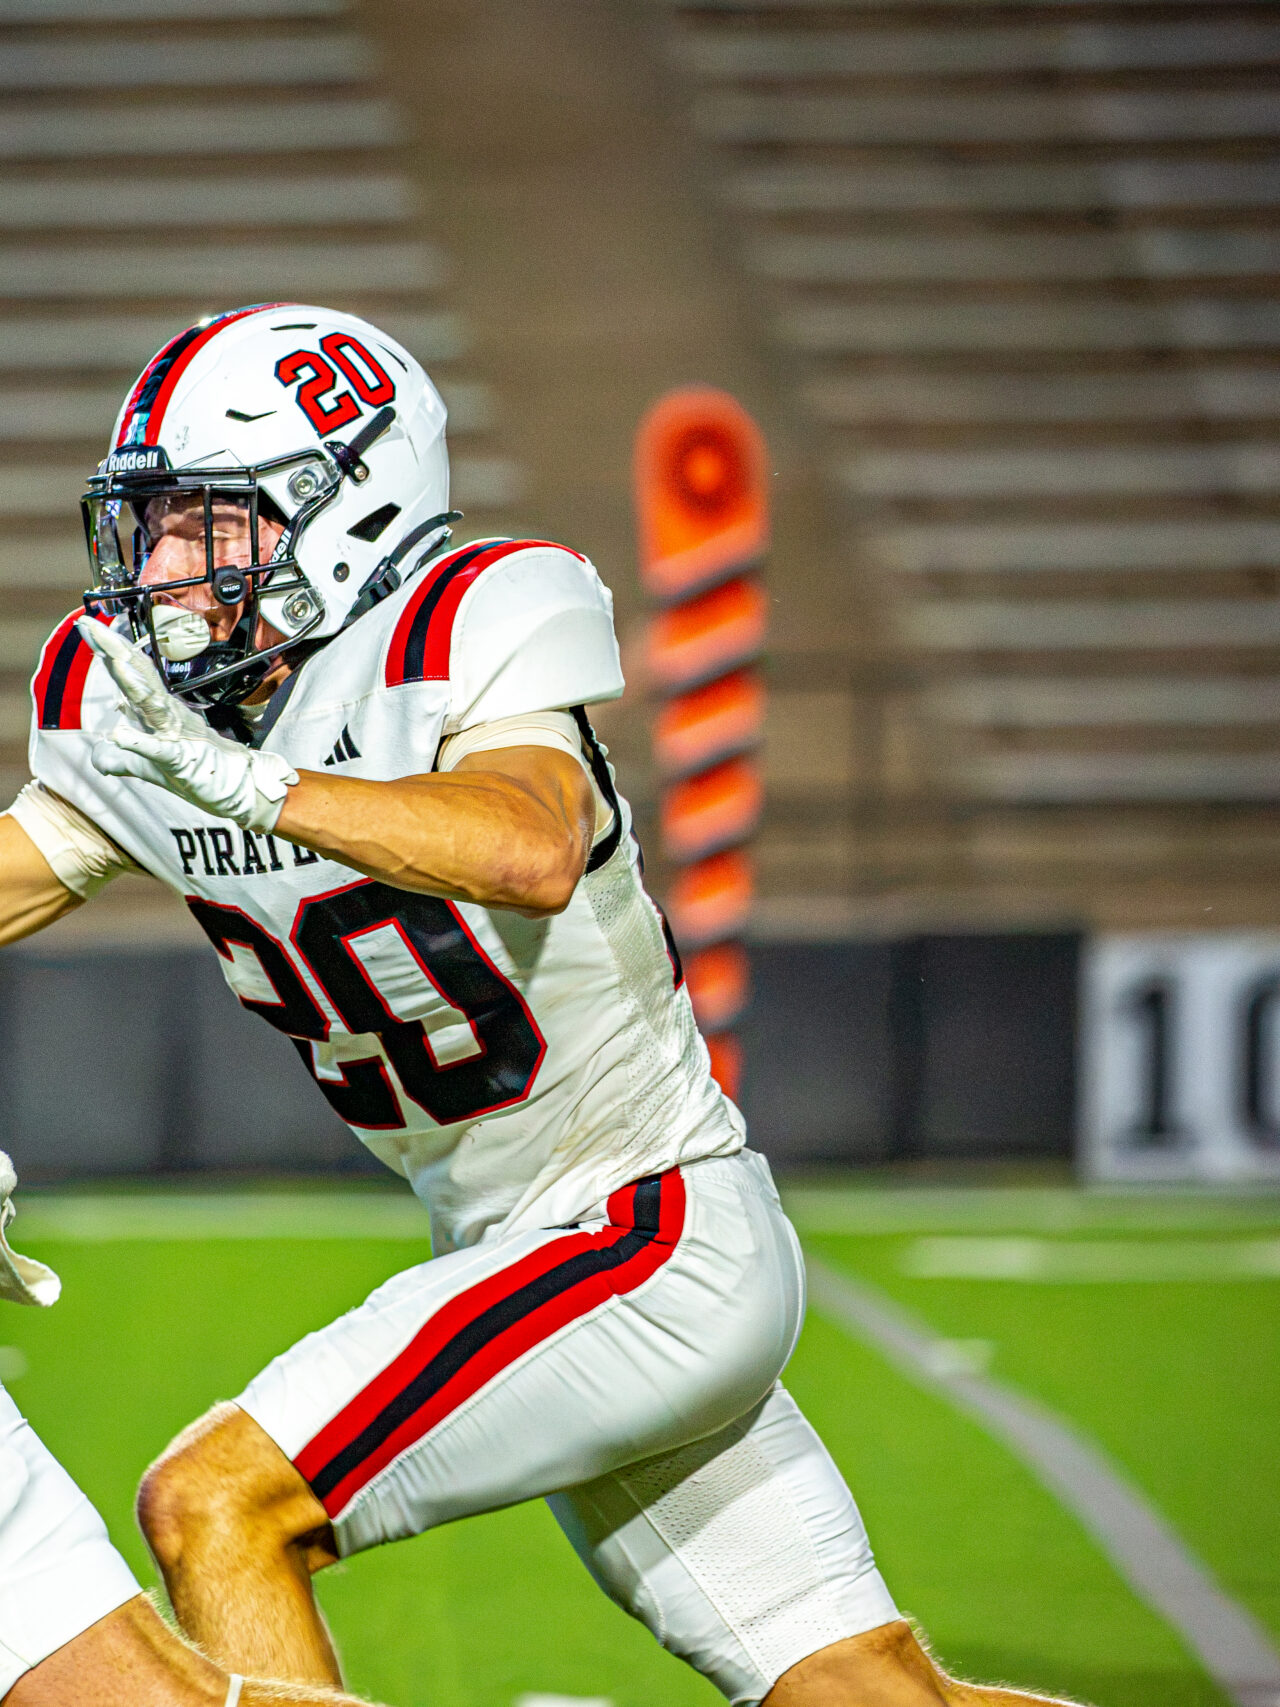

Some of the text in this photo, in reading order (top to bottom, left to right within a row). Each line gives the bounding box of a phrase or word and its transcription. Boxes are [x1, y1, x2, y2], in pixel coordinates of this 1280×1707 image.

[274, 331, 397, 440] 20
[108, 451, 158, 471] Riddell
[185, 876, 548, 1130] 20
